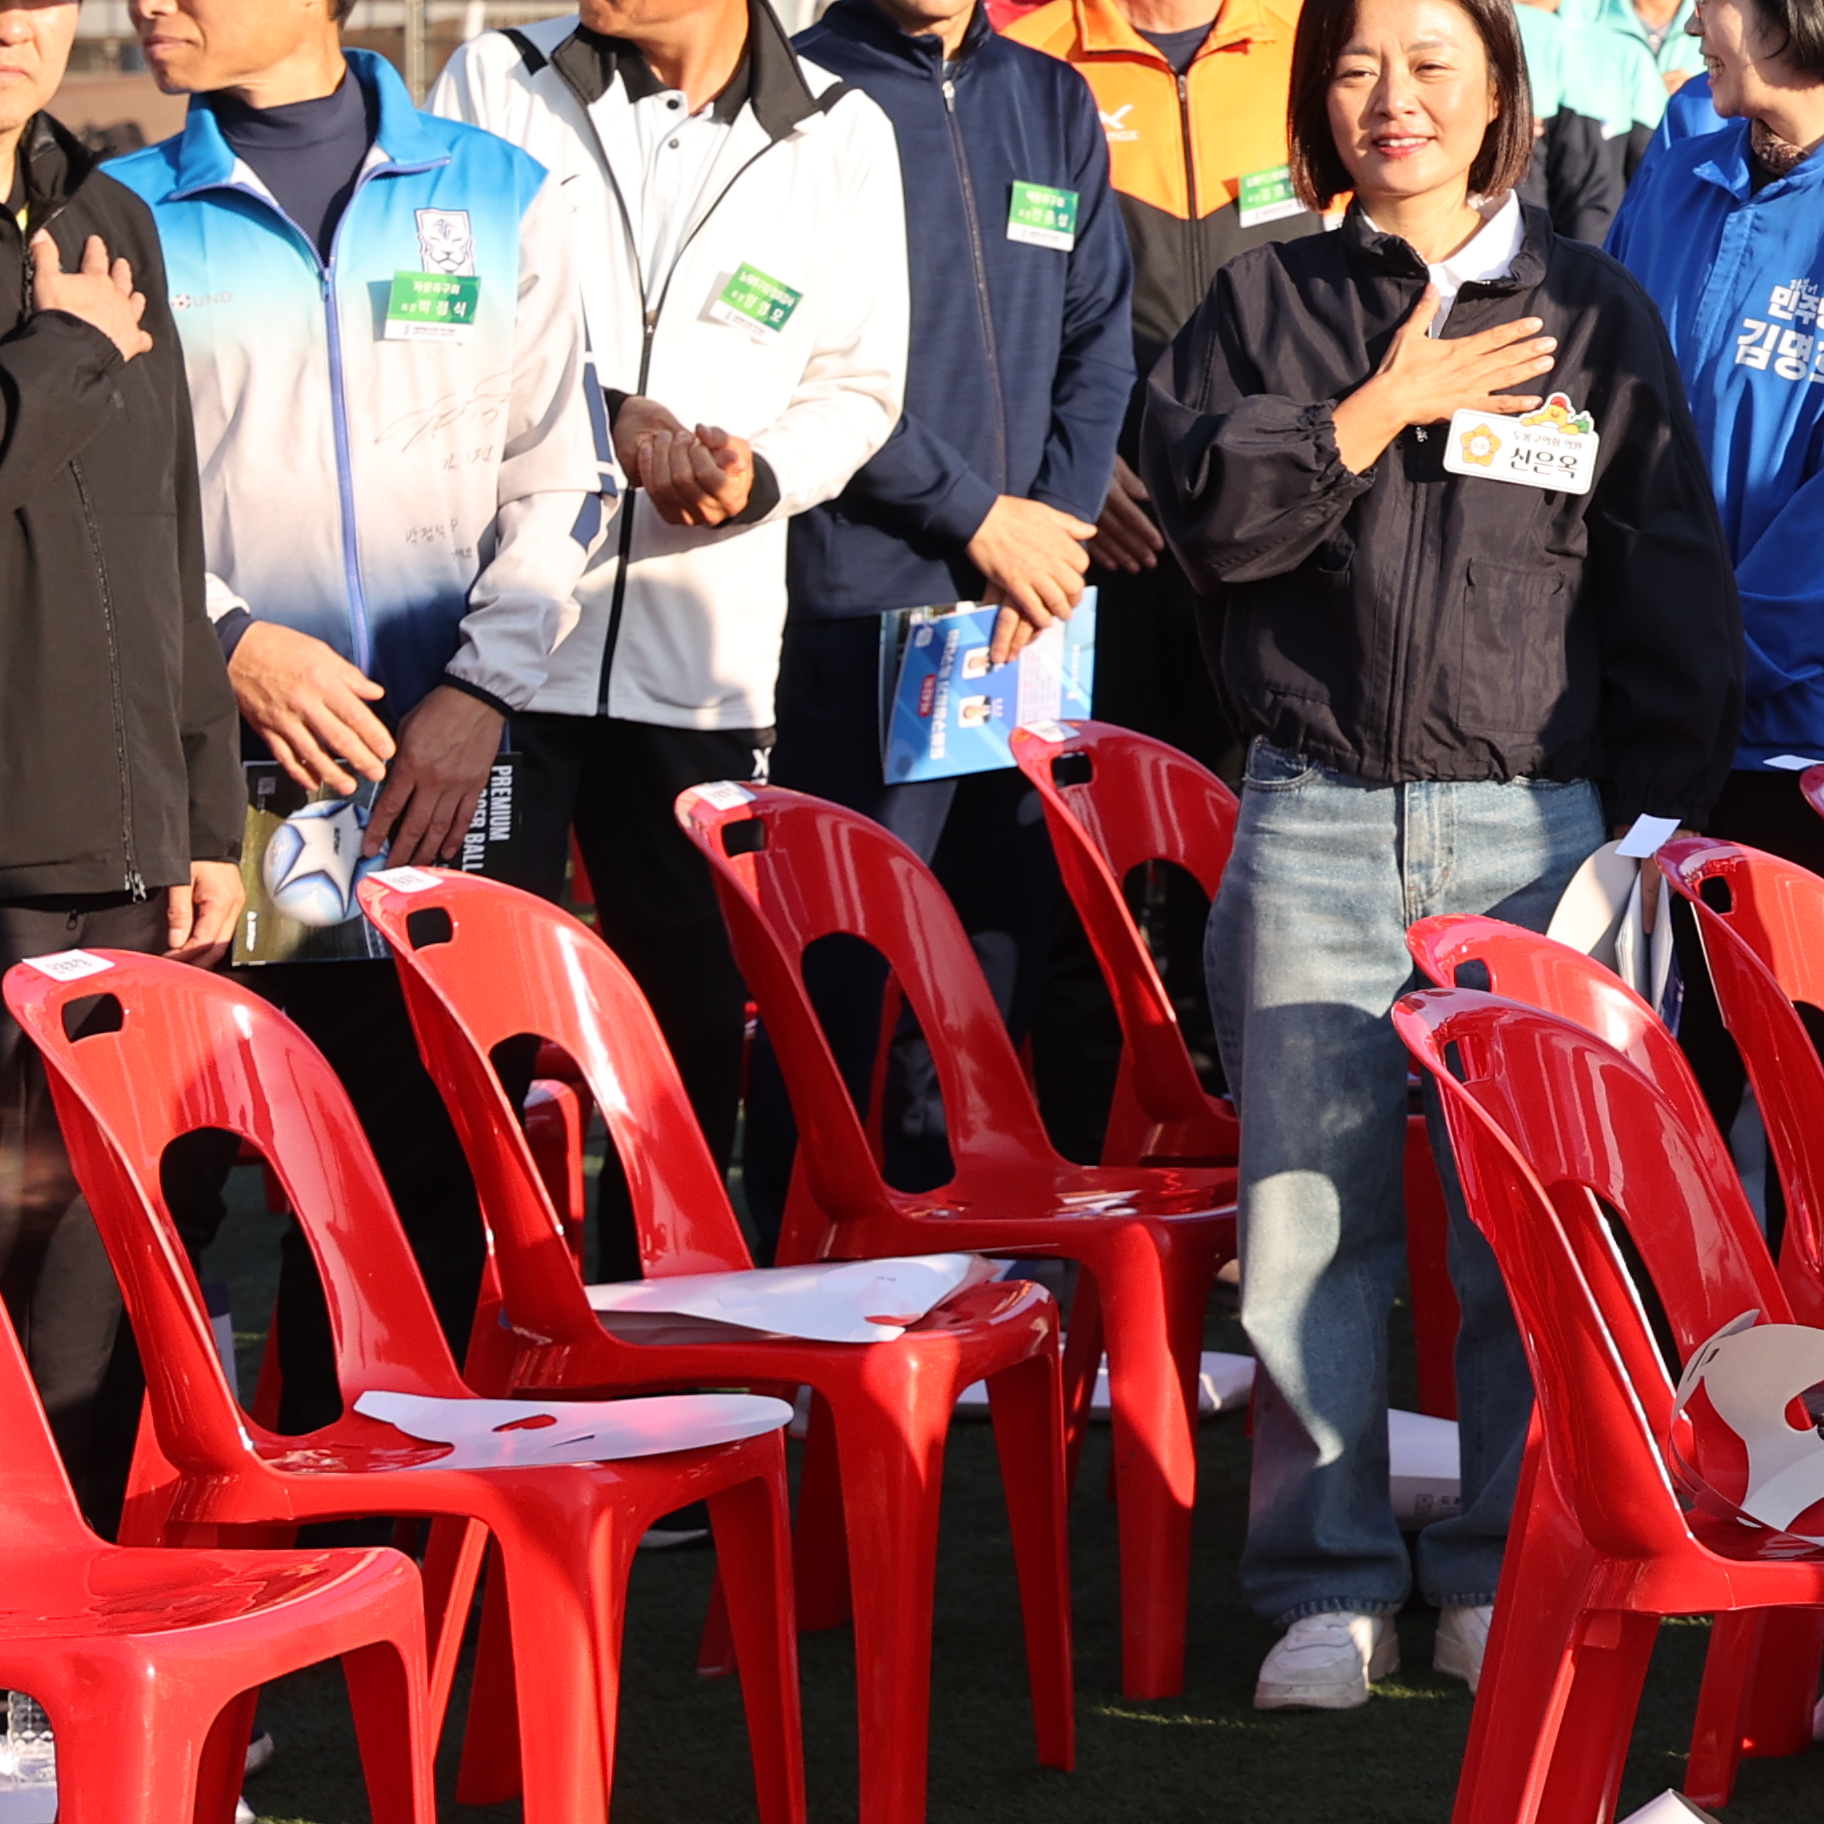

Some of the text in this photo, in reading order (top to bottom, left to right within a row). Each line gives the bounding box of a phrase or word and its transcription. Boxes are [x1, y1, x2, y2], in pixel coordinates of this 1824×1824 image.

[1513, 430, 1562, 447] 도봉구의회
[1509, 447, 1579, 480] 신은옥
[488, 764, 513, 842] PREMIUM
[461, 832, 486, 872] BALL
